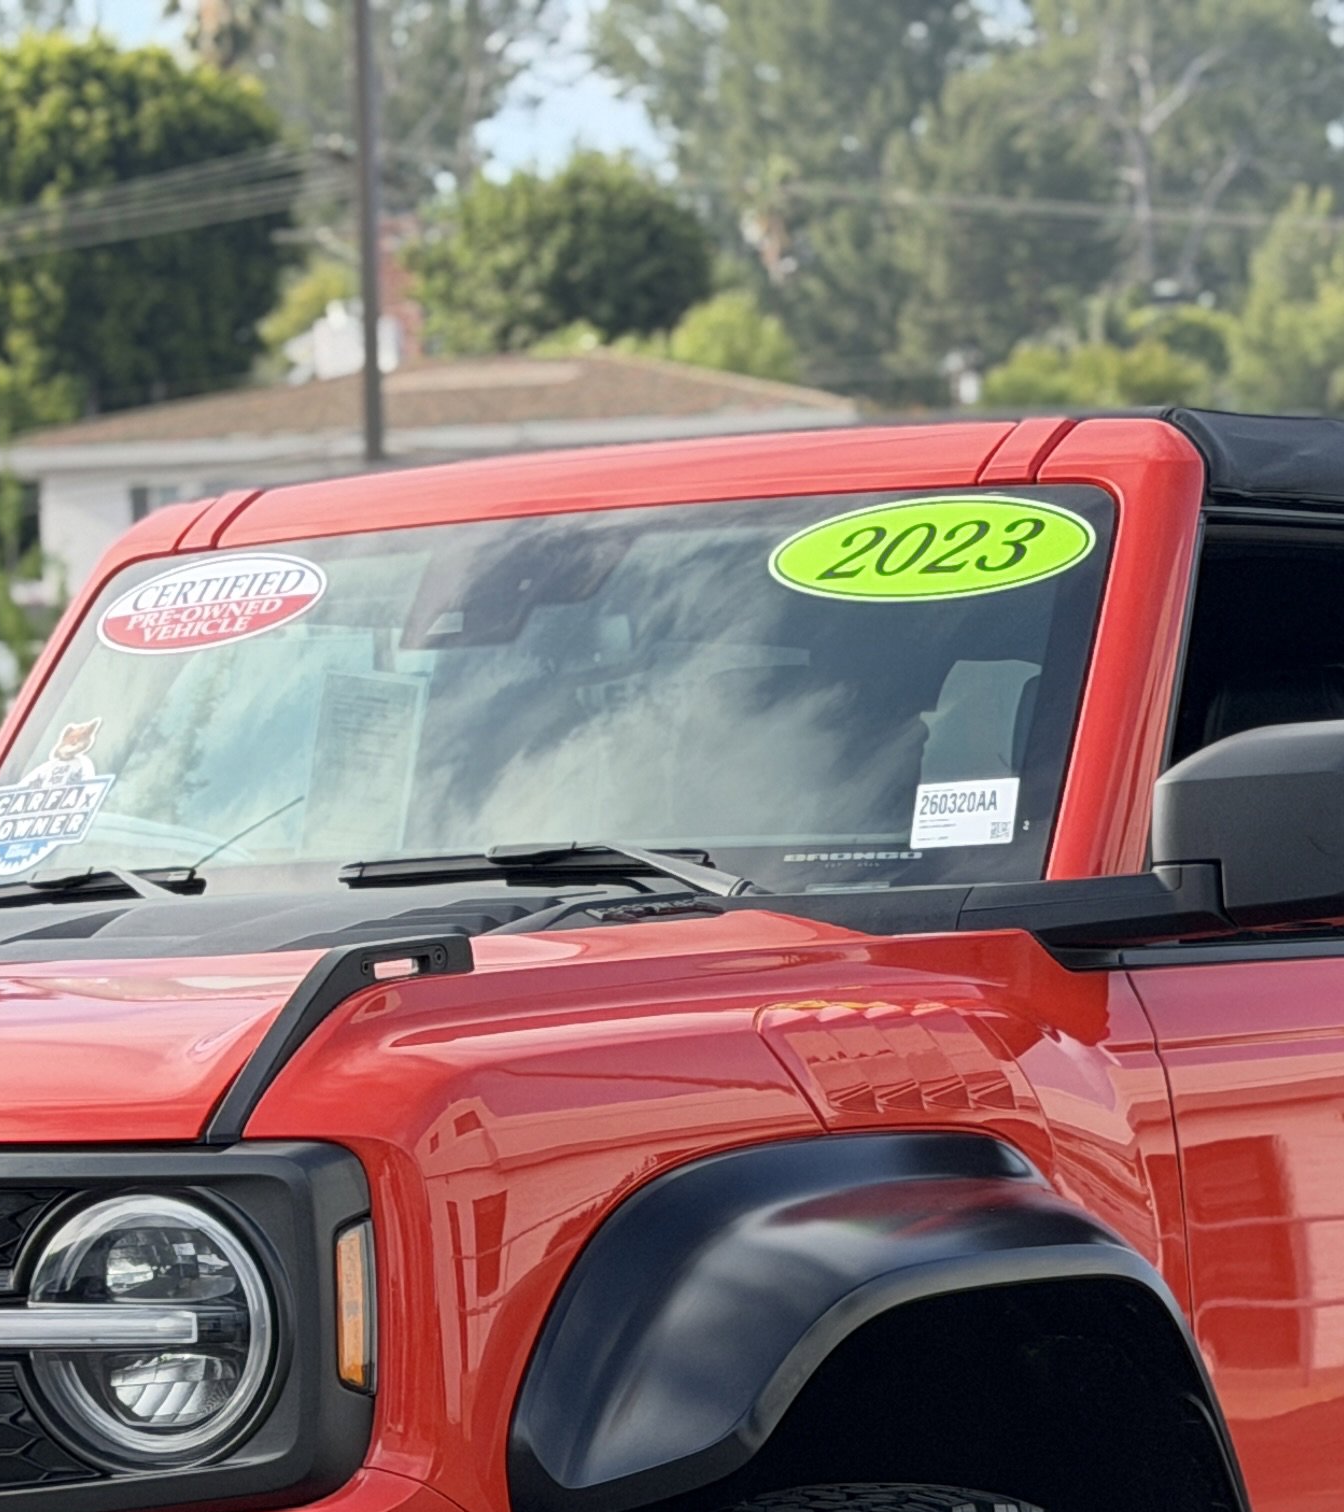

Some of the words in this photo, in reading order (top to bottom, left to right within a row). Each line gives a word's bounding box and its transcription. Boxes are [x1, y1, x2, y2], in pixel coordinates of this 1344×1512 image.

[815, 518, 1046, 581] 2023
[132, 569, 306, 612] CERTIFIED
[125, 598, 284, 632] PRE-OWNED
[142, 616, 252, 644] VEHICLE
[919, 789, 998, 816] 260320AA
